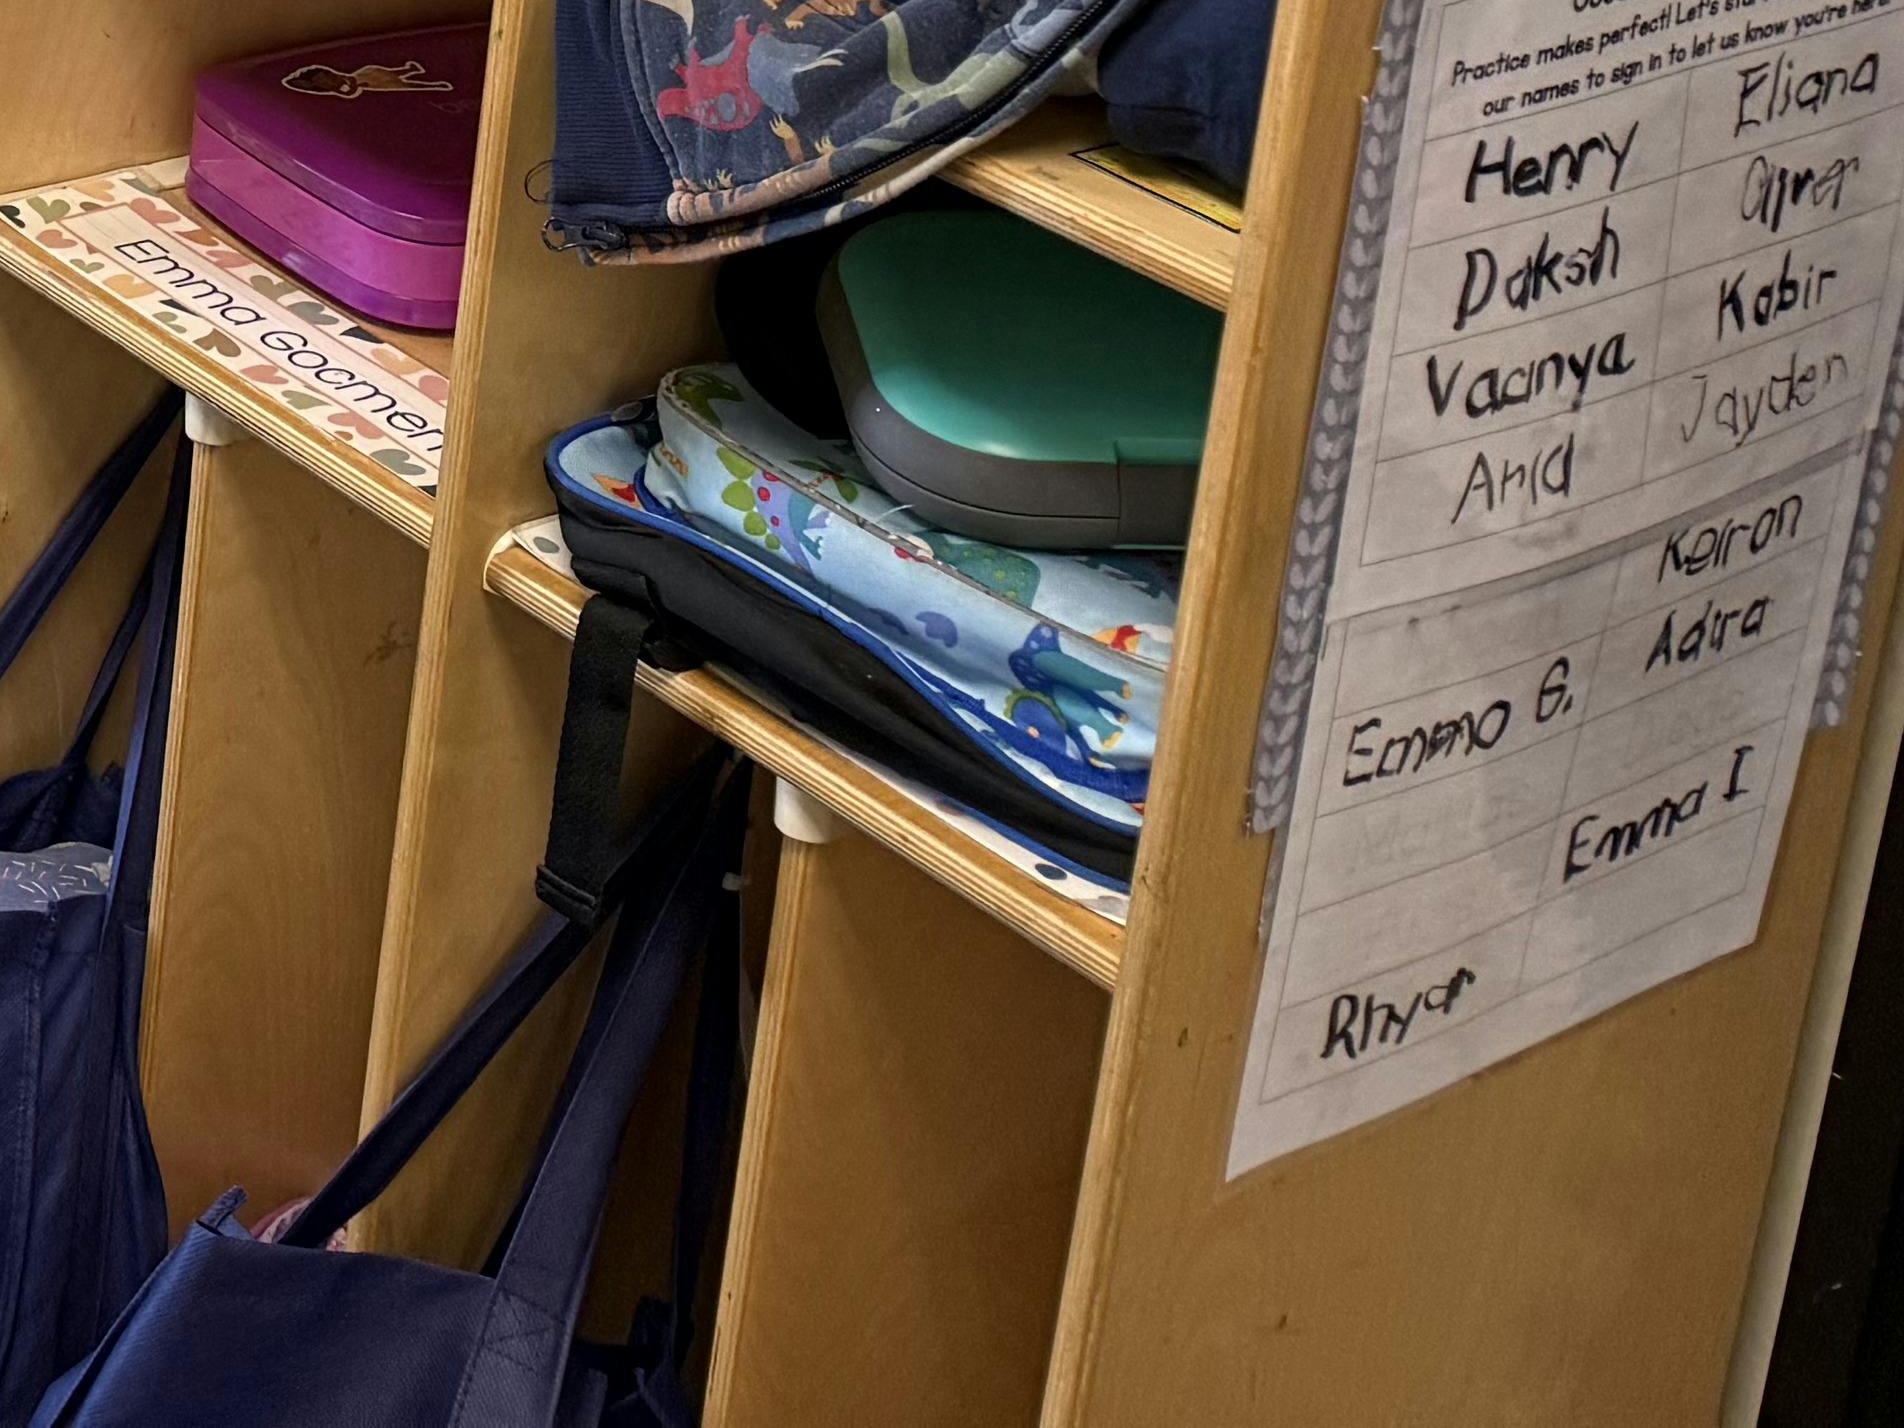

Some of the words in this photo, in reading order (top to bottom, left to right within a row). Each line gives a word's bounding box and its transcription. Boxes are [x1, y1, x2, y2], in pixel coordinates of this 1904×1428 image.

[1452, 52, 1532, 88] Practice
[1536, 34, 1596, 66] makes
[1598, 10, 1672, 55] perfect!
[1482, 92, 1517, 118] our
[1520, 77, 1580, 107] names
[1585, 66, 1606, 89] to
[1610, 52, 1644, 86] sign
[1648, 51, 1663, 72] in
[1669, 43, 1688, 65] to
[1691, 33, 1716, 62] let
[1720, 30, 1740, 51] us
[1744, 14, 1790, 45] know
[1794, 1, 1848, 36] you're
[1464, 120, 1640, 204] Henry
[114, 238, 267, 327] Emma
[1453, 205, 1621, 332] Daksh
[1717, 249, 1839, 342] Kabir
[1679, 350, 1848, 448] Jayden
[1562, 781, 1709, 885] Emma
